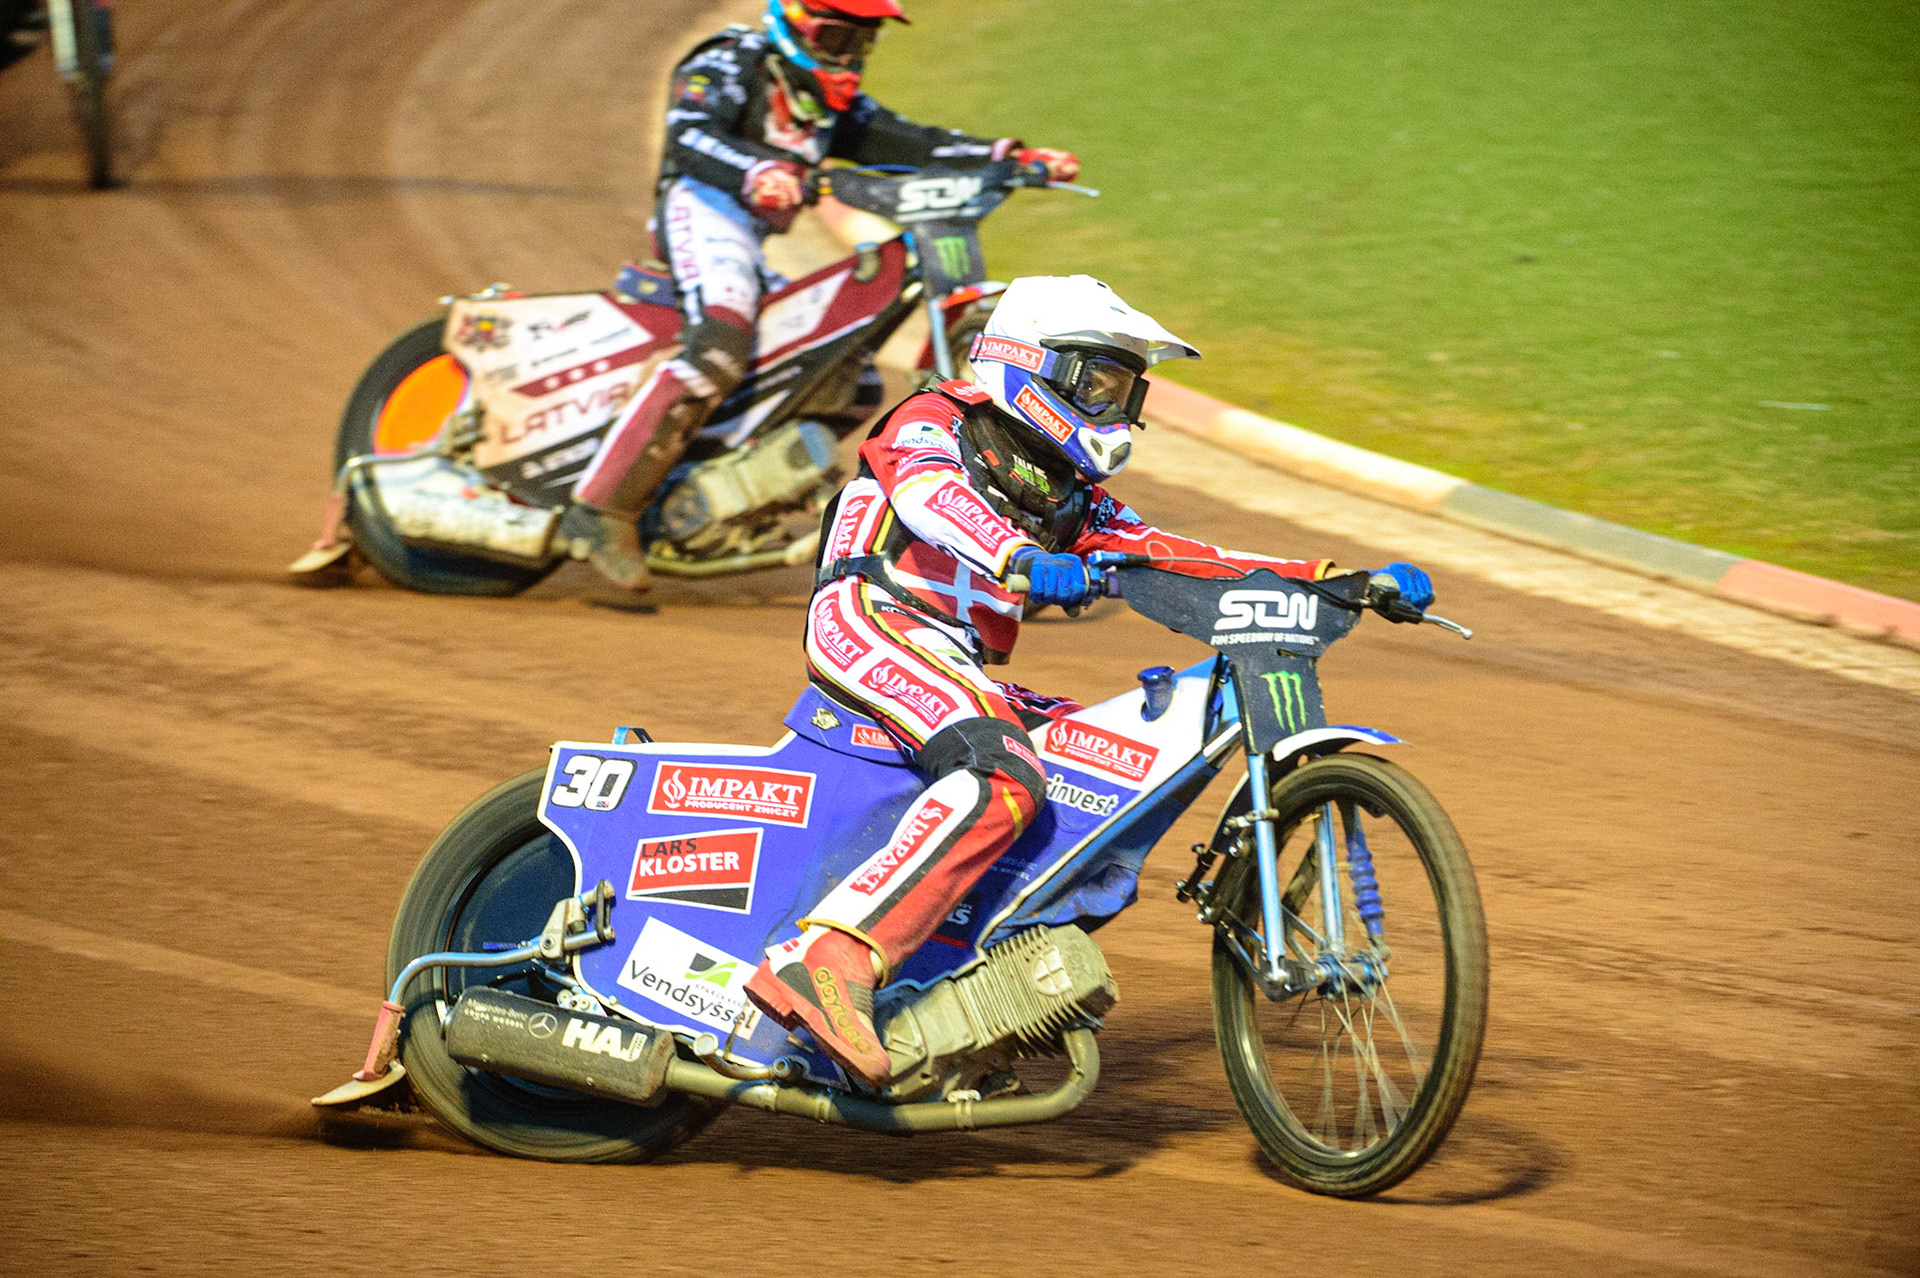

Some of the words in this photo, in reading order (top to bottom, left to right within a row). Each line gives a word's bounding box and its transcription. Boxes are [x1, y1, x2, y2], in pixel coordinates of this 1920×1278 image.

[987, 341, 1041, 361] IMPAKT
[1029, 400, 1070, 435] IMPAKT
[837, 517, 859, 555] IMP
[950, 494, 1013, 541] IMPAKT
[820, 607, 865, 661] IMPAKT
[887, 671, 951, 718] IMPAKT
[1068, 728, 1153, 769] IMPAKT
[551, 754, 637, 812] 30
[689, 777, 804, 806] IMPAKT
[1047, 776, 1115, 814] invest
[684, 800, 753, 813] PRODUCENT
[753, 805, 799, 818] ZNICZY
[639, 851, 741, 877] KLOSTER
[641, 837, 698, 858] LARS
[855, 819, 931, 892] IMPAKT
[631, 959, 758, 1030] Vendsyssel
[561, 1017, 648, 1063] HAJ
